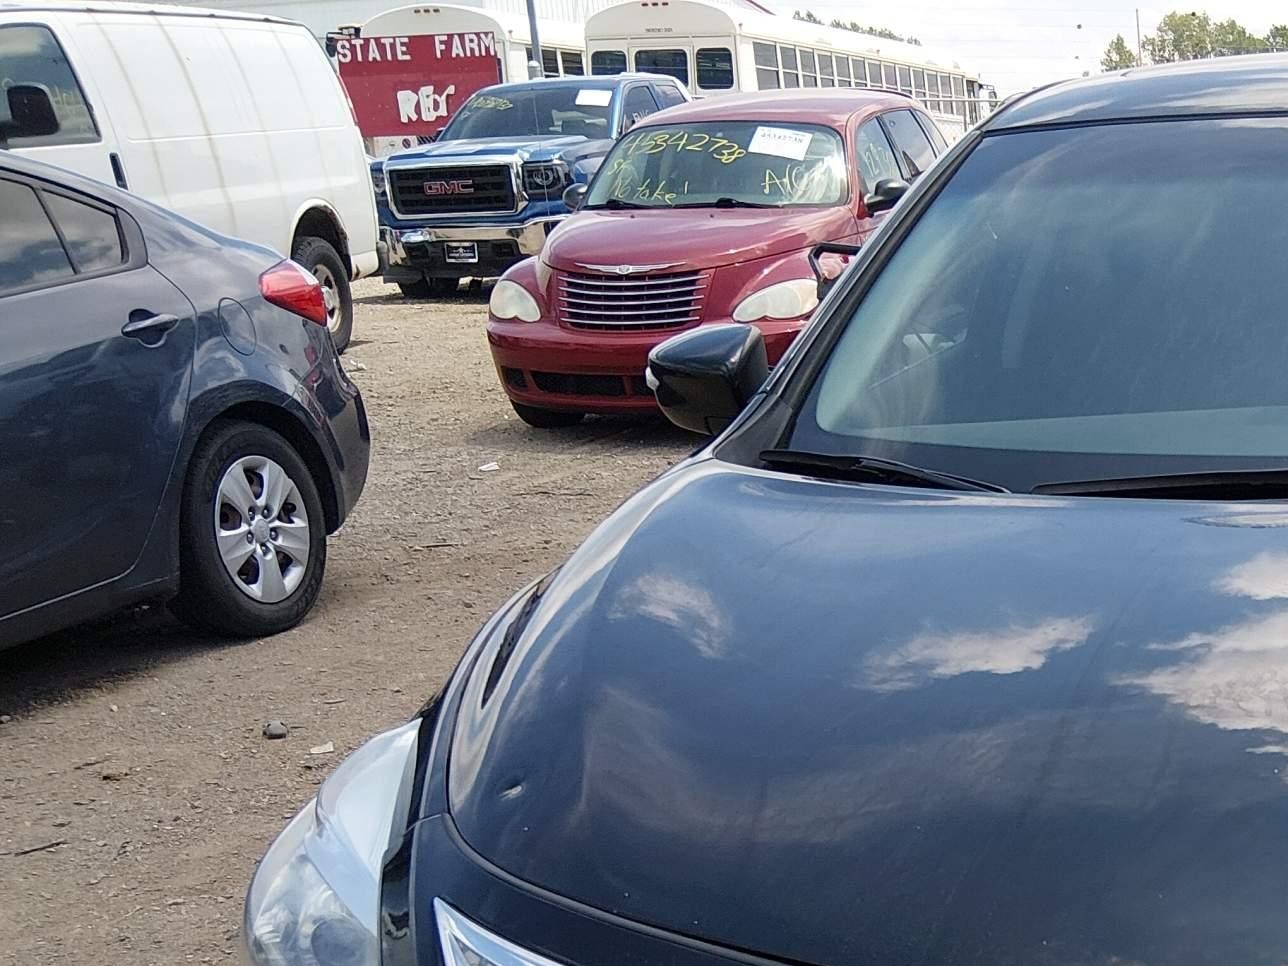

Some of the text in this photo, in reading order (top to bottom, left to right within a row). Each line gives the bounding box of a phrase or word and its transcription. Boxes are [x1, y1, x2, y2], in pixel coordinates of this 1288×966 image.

[336, 32, 495, 63] STATE FARM
[424, 180, 474, 195] GMC
